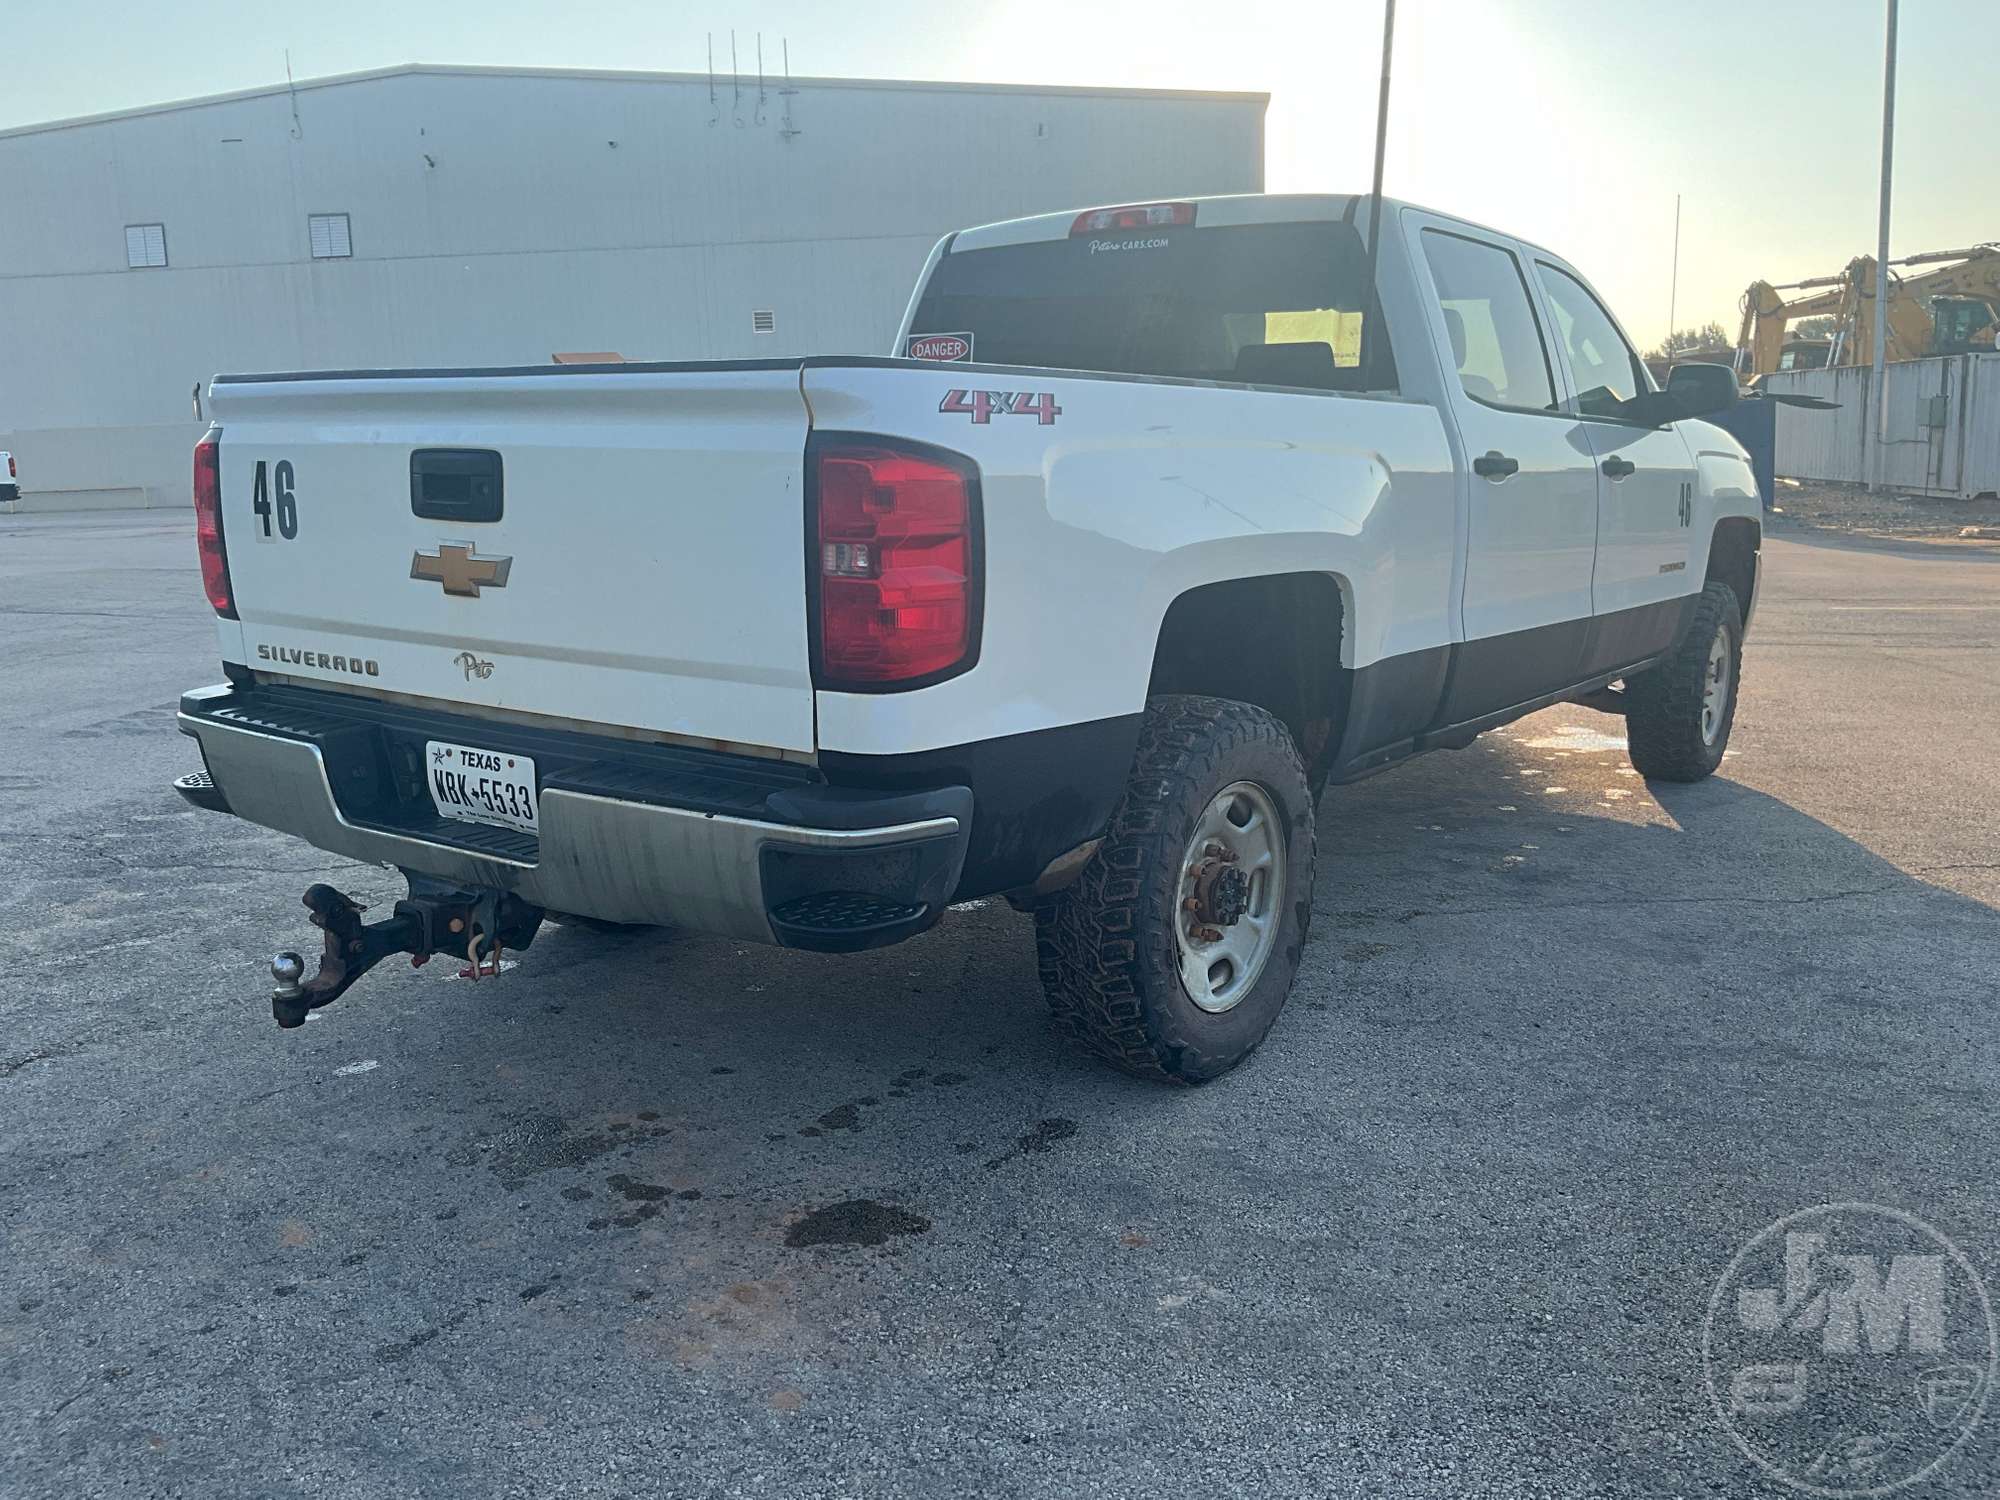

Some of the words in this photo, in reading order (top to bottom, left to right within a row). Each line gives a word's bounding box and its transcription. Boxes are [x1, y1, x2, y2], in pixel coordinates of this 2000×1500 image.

[916, 342, 962, 357] DANGER
[254, 460, 298, 540] 46
[1679, 482, 1692, 528] 46
[257, 644, 379, 677] SILVERADO
[461, 750, 502, 773] TEXAS
[480, 778, 534, 821] 5533
